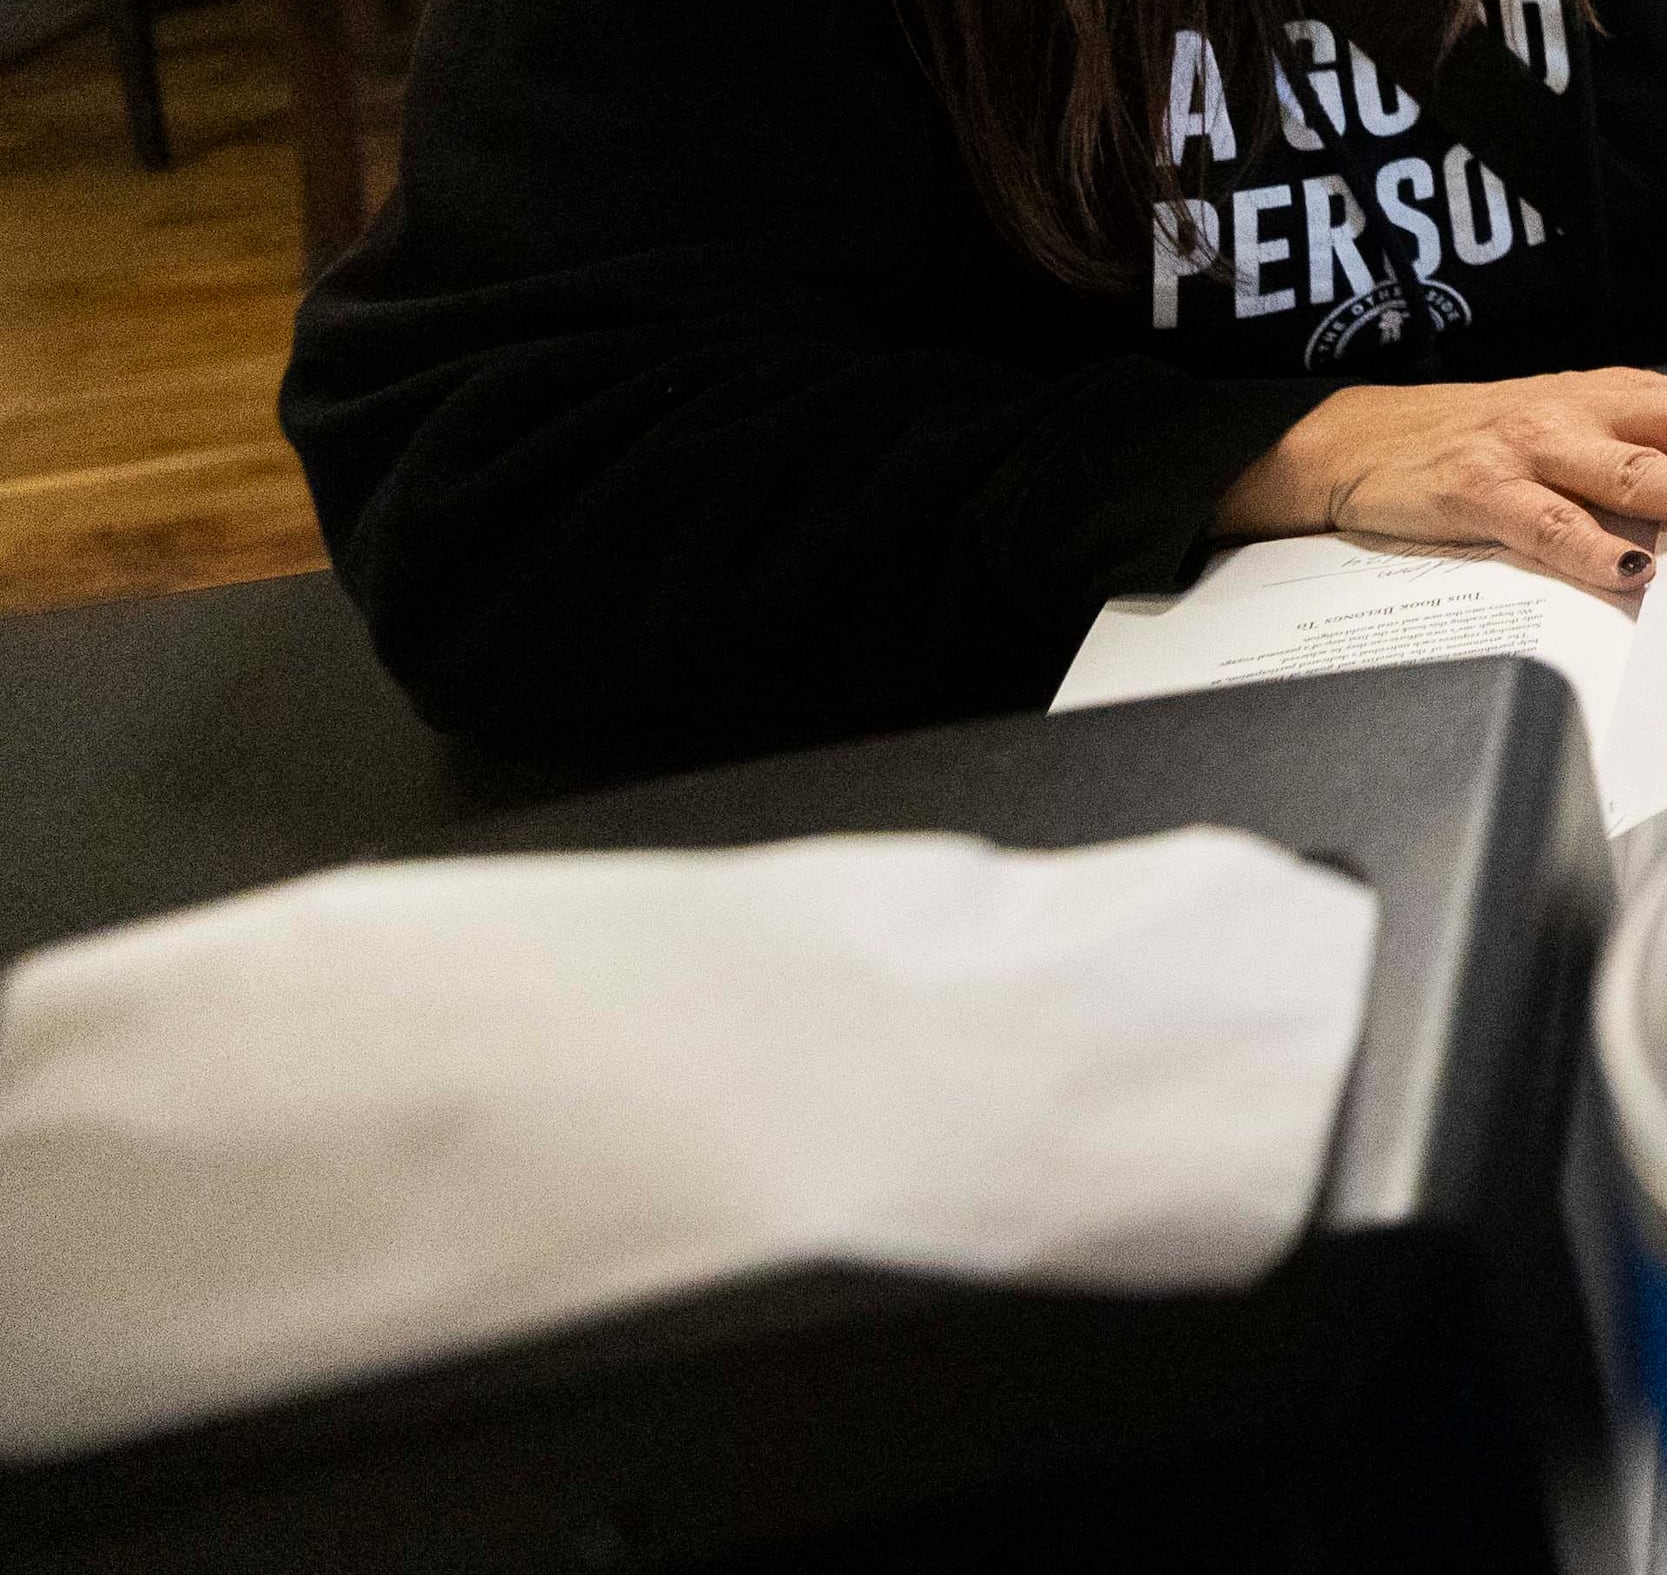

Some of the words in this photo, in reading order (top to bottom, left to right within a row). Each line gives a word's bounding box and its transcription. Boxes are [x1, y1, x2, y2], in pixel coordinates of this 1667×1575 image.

[1155, 29, 1237, 165] A
[1447, 592, 1483, 603] THIS
[1400, 599, 1441, 611] BOOK
[1324, 608, 1394, 625] BELONGS
[1296, 621, 1319, 630] TO
